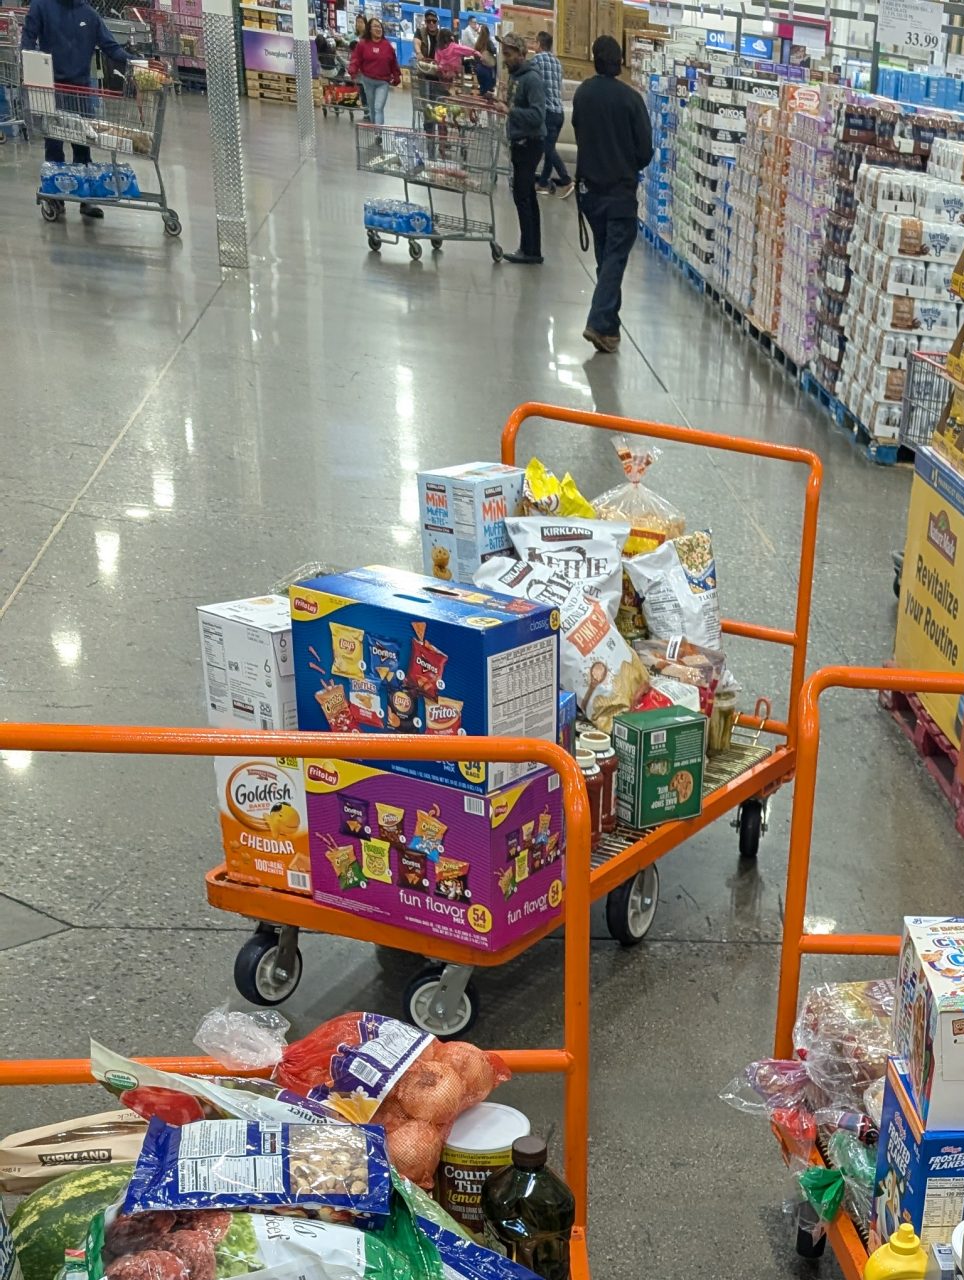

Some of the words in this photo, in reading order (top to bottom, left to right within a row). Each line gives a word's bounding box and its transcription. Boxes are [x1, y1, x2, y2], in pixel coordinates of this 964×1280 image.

[904, 31, 939, 49] 33.99
[543, 526, 592, 539] KIRKLAND
[915, 553, 959, 621] Revitalize
[573, 624, 595, 649] PINK
[905, 589, 924, 625] your
[923, 605, 959, 667] Routine
[372, 645, 397, 661] Doritos
[416, 657, 438, 675] Doritos
[429, 705, 457, 721] Fritos
[235, 781, 292, 805] Goldfish
[240, 831, 295, 854] CHEDDAR
[399, 889, 422, 908] fun
[425, 895, 466, 920] flavor
[507, 906, 522, 925] fun
[523, 892, 549, 913] flavor
[452, 916, 466, 926] MIX
[473, 908, 487, 923] 54
[41, 1149, 110, 1165] KIRKLAND
